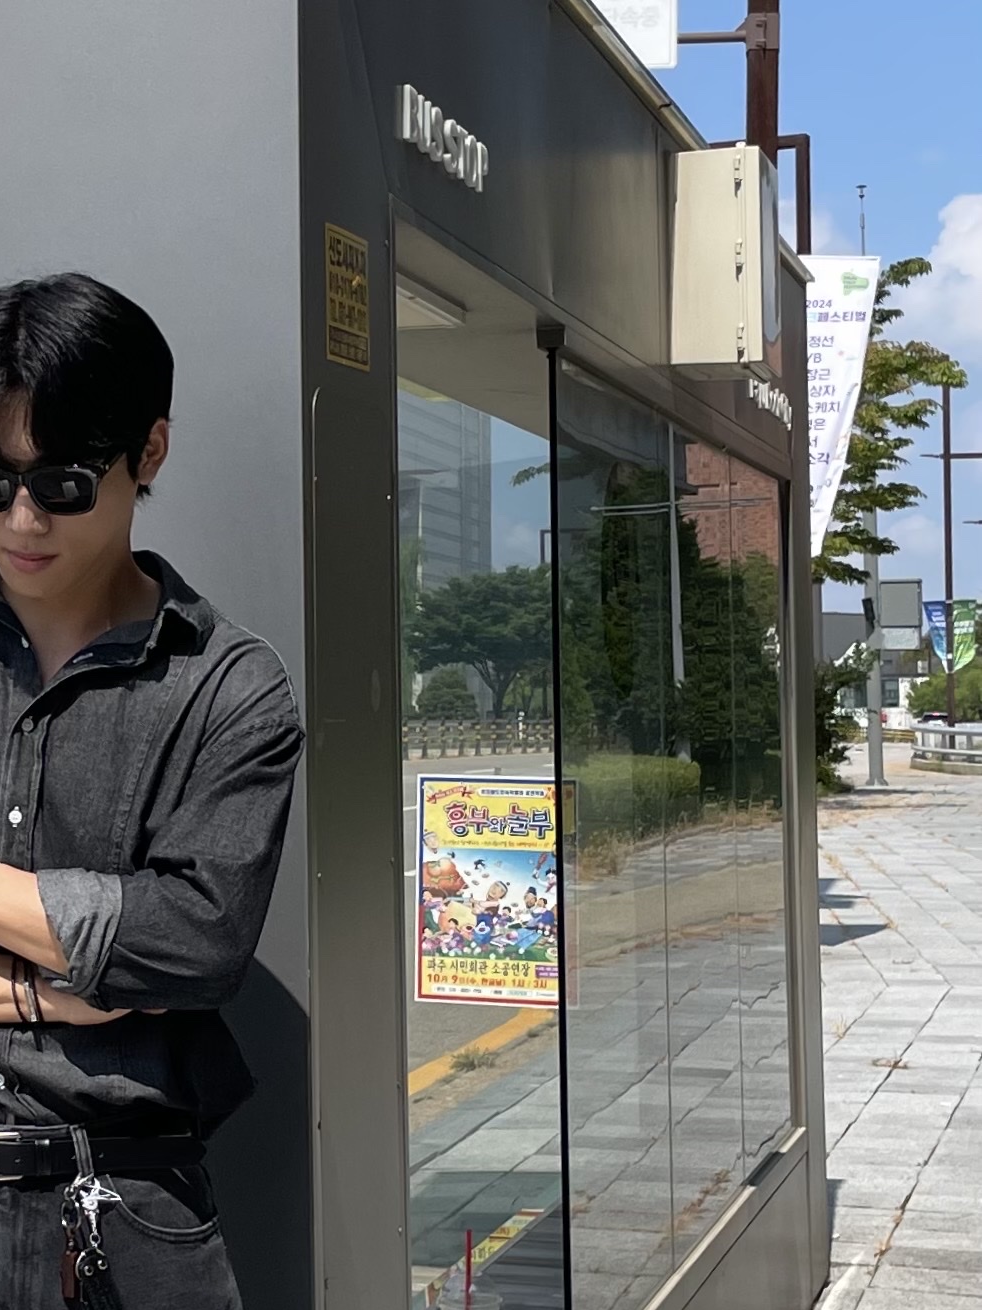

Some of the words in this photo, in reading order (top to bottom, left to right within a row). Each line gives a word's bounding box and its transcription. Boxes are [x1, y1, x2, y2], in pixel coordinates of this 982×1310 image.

[402, 84, 443, 162] BUS
[443, 119, 489, 192] STOP
[806, 299, 833, 309] 2024
[427, 958, 447, 973] 파주
[450, 959, 488, 975] 시민회관
[491, 962, 531, 978] 소공연장
